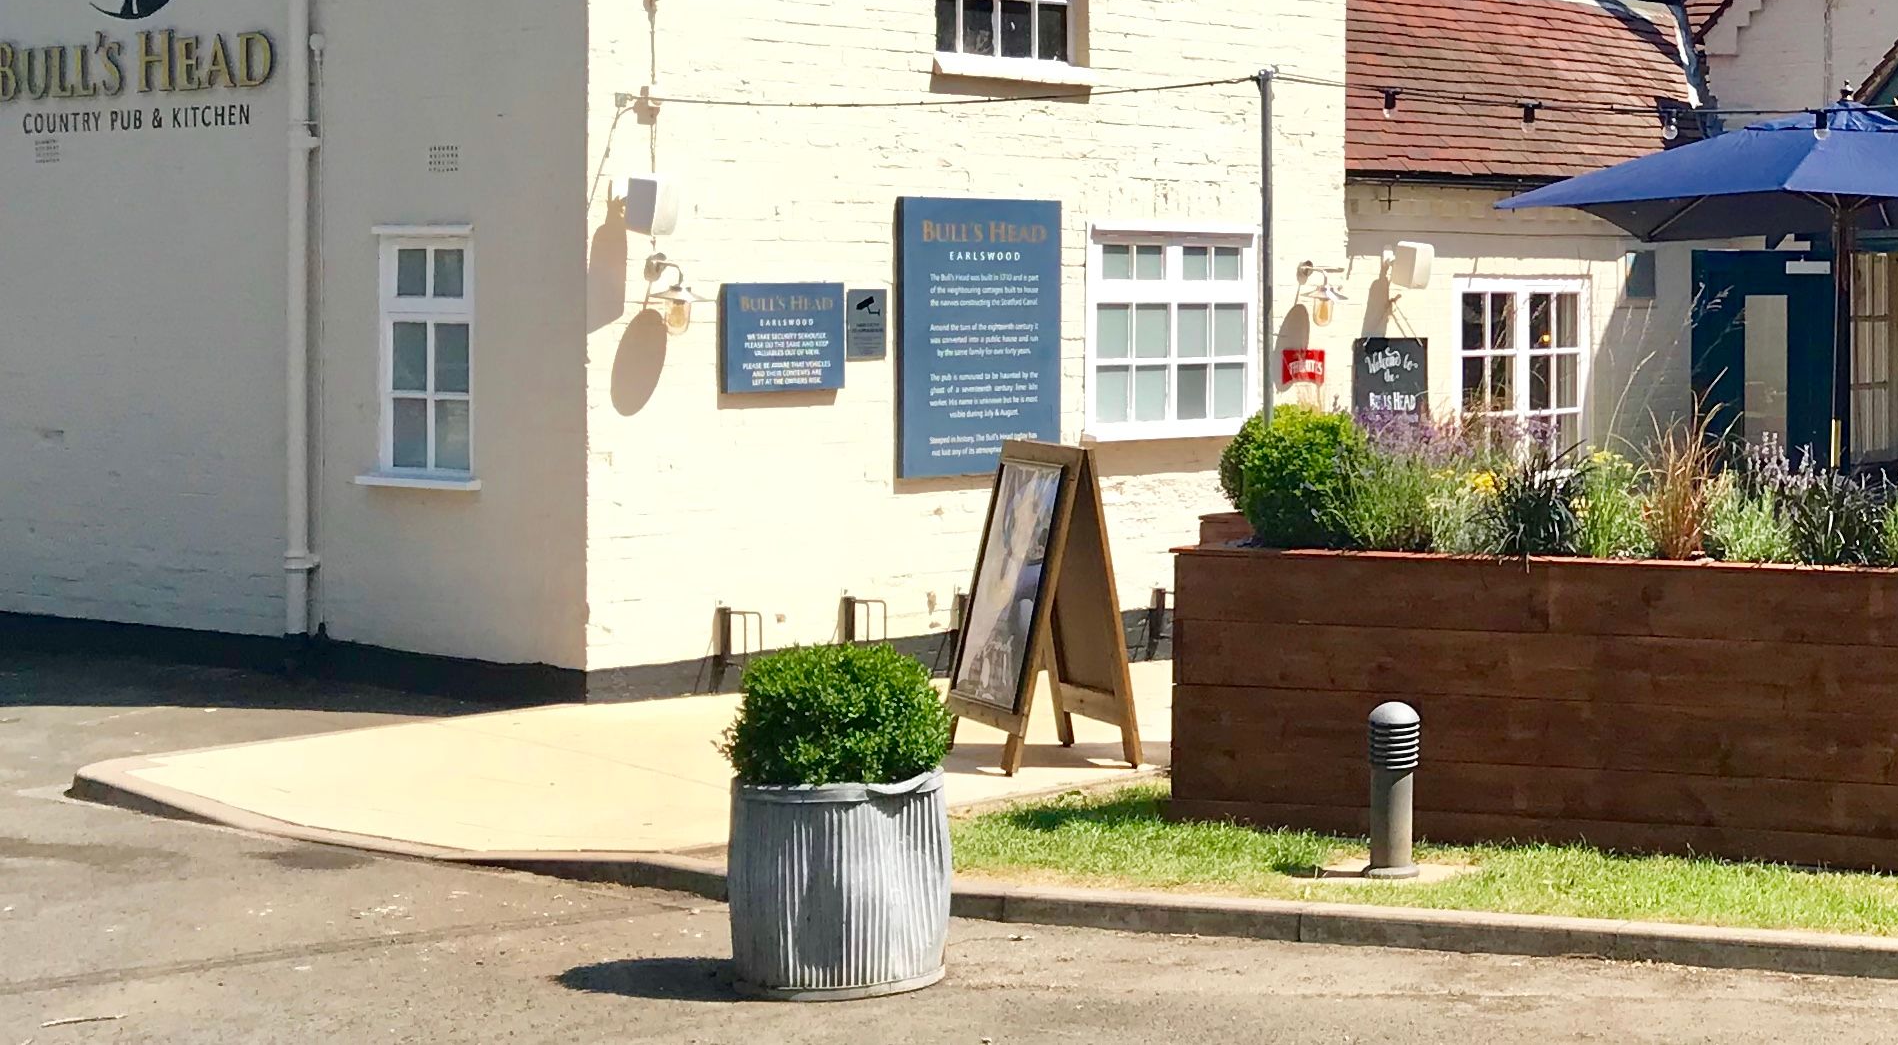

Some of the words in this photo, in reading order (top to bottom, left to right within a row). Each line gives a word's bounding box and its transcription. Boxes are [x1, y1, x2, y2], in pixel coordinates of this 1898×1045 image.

[0, 31, 122, 101] BULL'S
[136, 28, 276, 93] HEAD
[23, 110, 100, 135] COUNTRY
[110, 108, 142, 132] PUB
[152, 108, 162, 129] &
[172, 104, 251, 129] KITCHEN
[922, 219, 983, 243] BULL'S
[989, 220, 1047, 244] HEAD
[949, 251, 1020, 261] EARLSWOOD
[741, 294, 785, 312] BULL'S
[790, 294, 833, 311] HEAD
[760, 318, 814, 327] EARLSWOOD
[1393, 392, 1416, 411] HEAD
